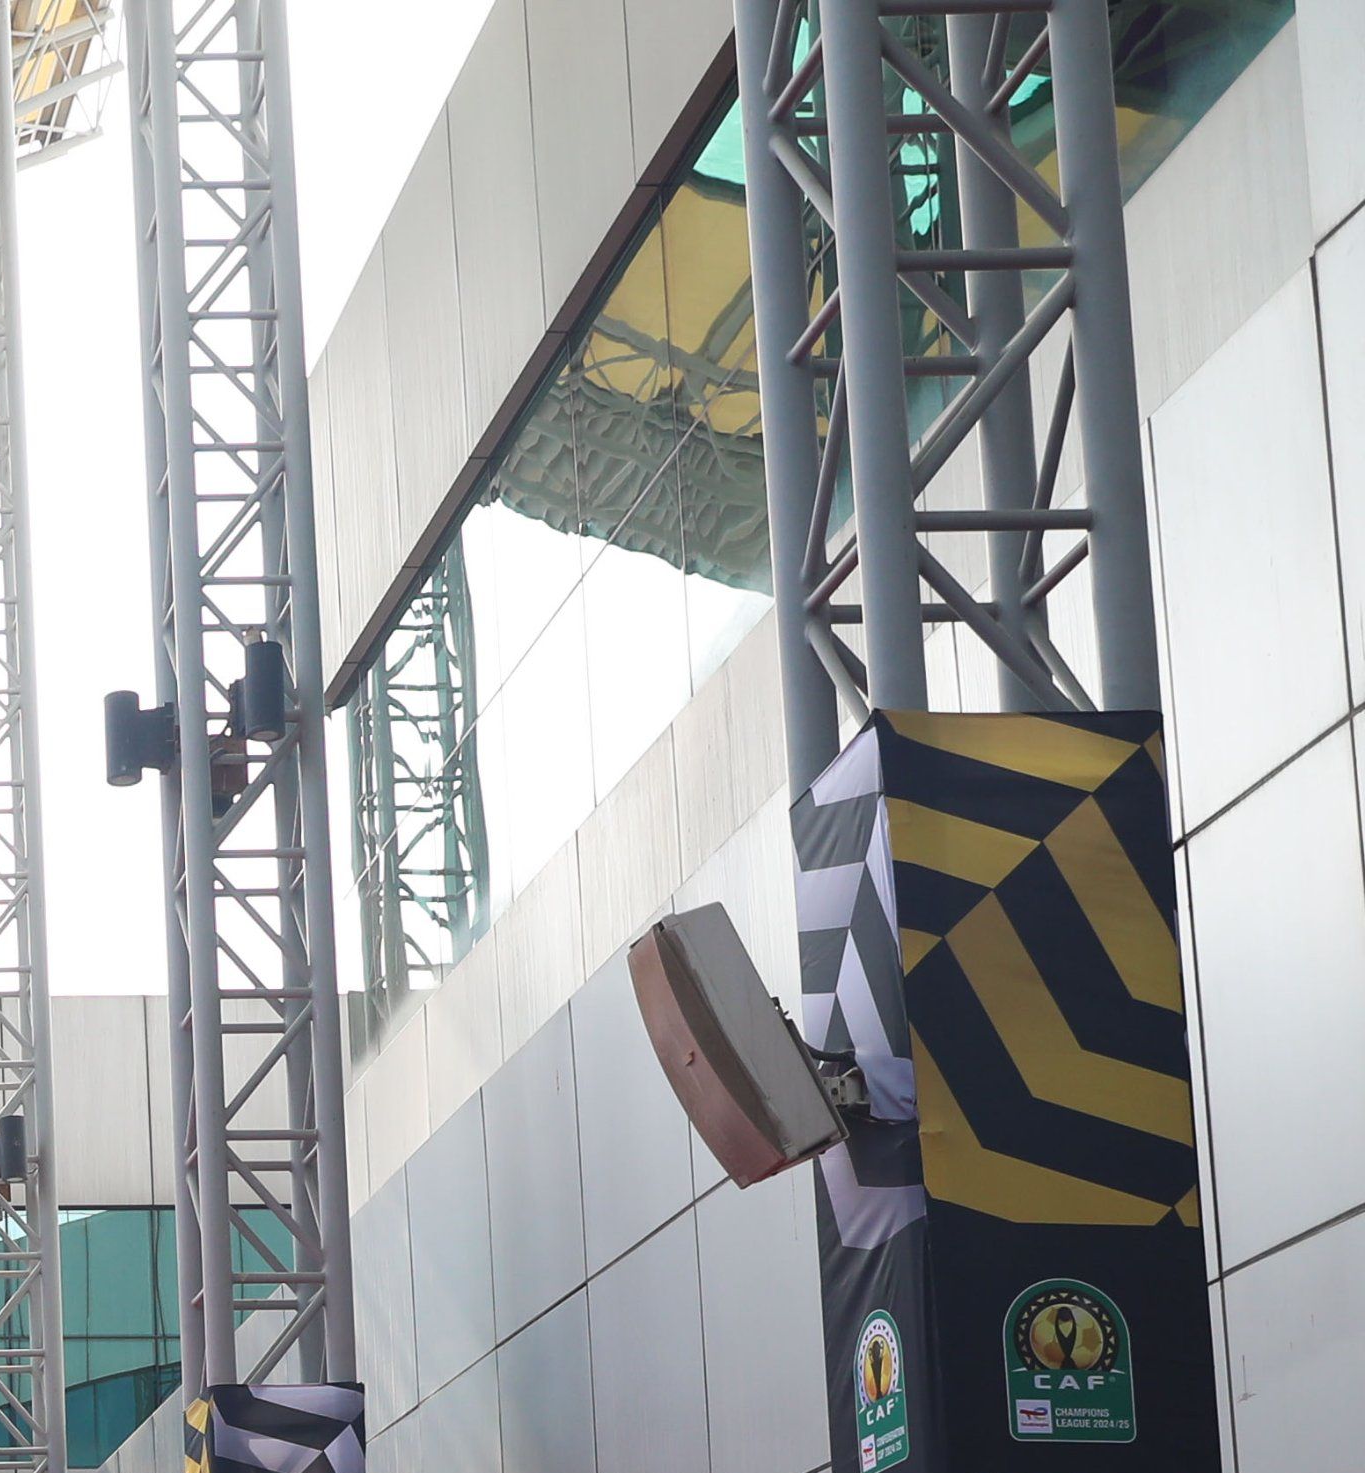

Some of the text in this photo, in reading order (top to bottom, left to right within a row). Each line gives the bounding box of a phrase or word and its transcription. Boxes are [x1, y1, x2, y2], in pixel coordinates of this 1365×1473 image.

[1034, 1374, 1105, 1390] CAF
[866, 1398, 895, 1426] CAF
[1054, 1407, 1110, 1418] CHAMPIONS
[1056, 1419, 1090, 1428] LEAGUE
